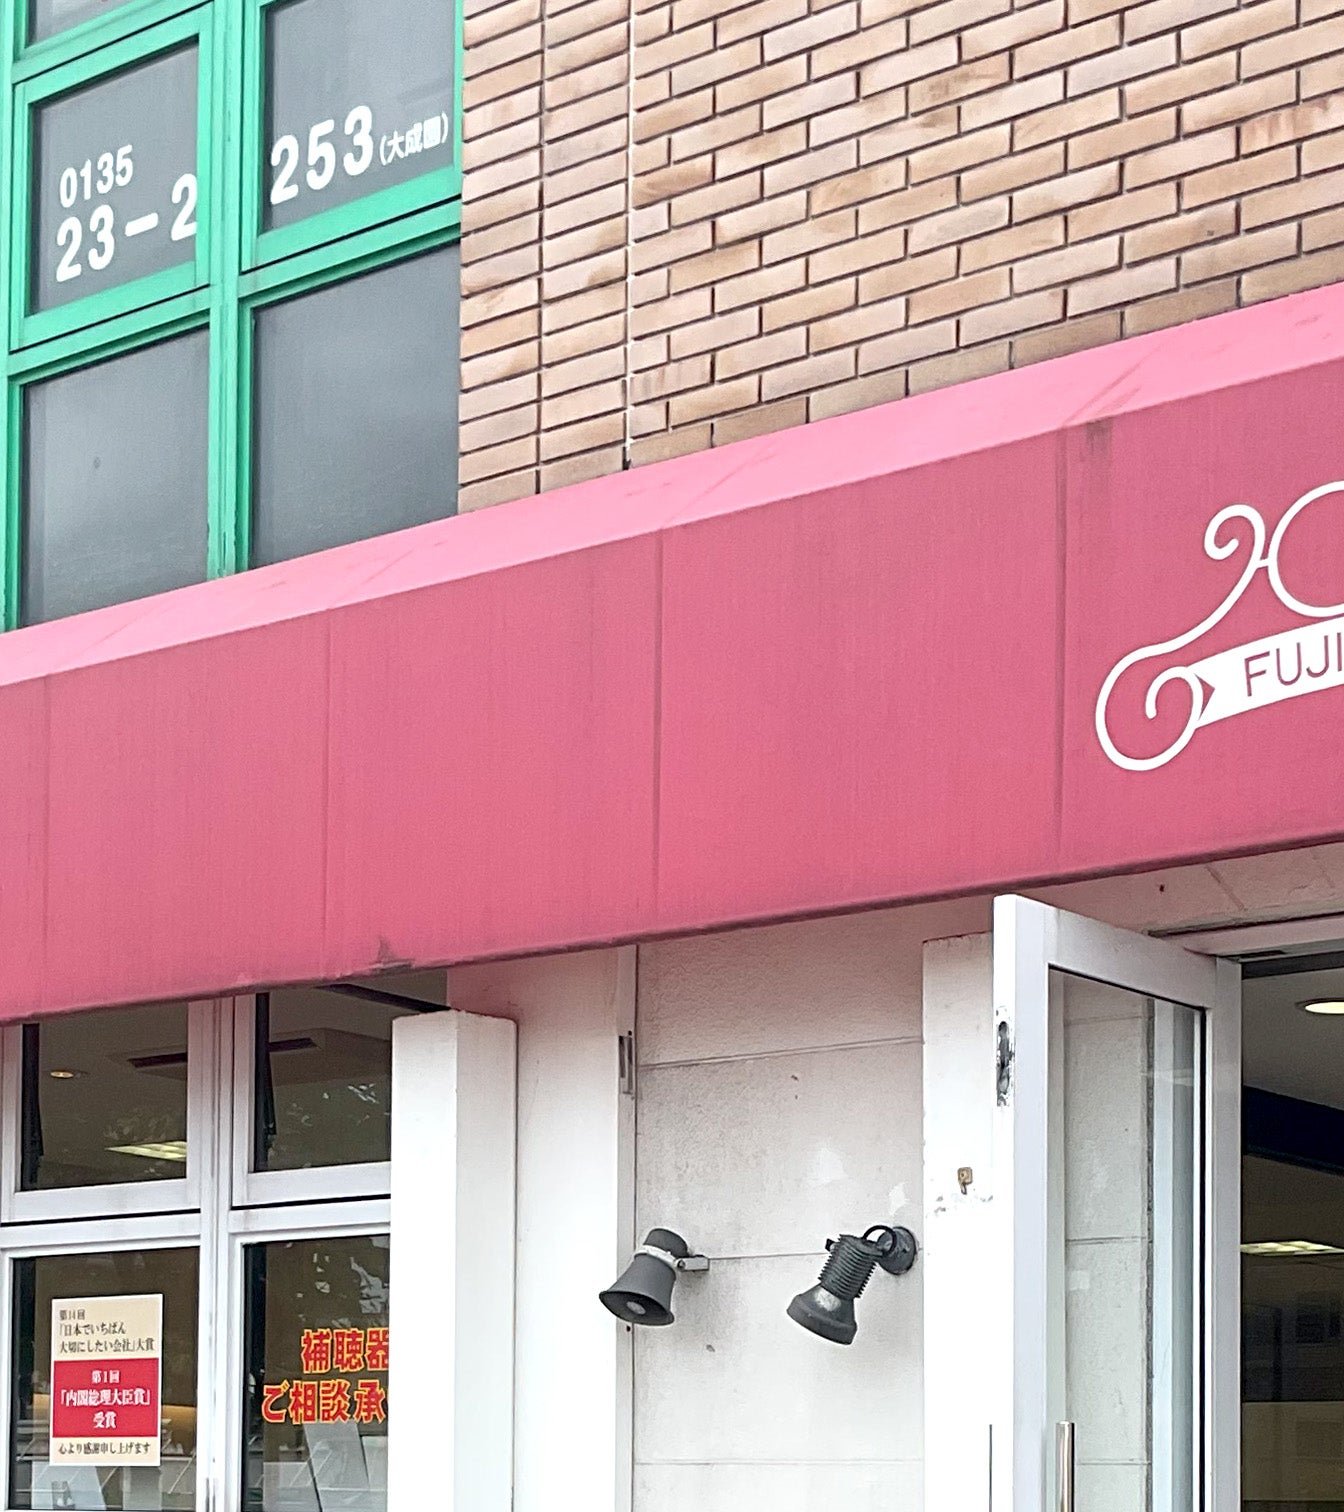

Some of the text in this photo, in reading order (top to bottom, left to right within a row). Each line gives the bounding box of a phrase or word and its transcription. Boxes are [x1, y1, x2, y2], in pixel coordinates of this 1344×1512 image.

[59, 144, 134, 208] 0135
[1242, 632, 1344, 698] FUJI
[301, 1327, 390, 1374] 補聴器
[60, 1387, 151, 1407] 「内閣総理大臣賞」
[91, 1370, 121, 1384] 第1回
[93, 1411, 117, 1429] 受賞
[261, 1379, 386, 1425] ご相談承
